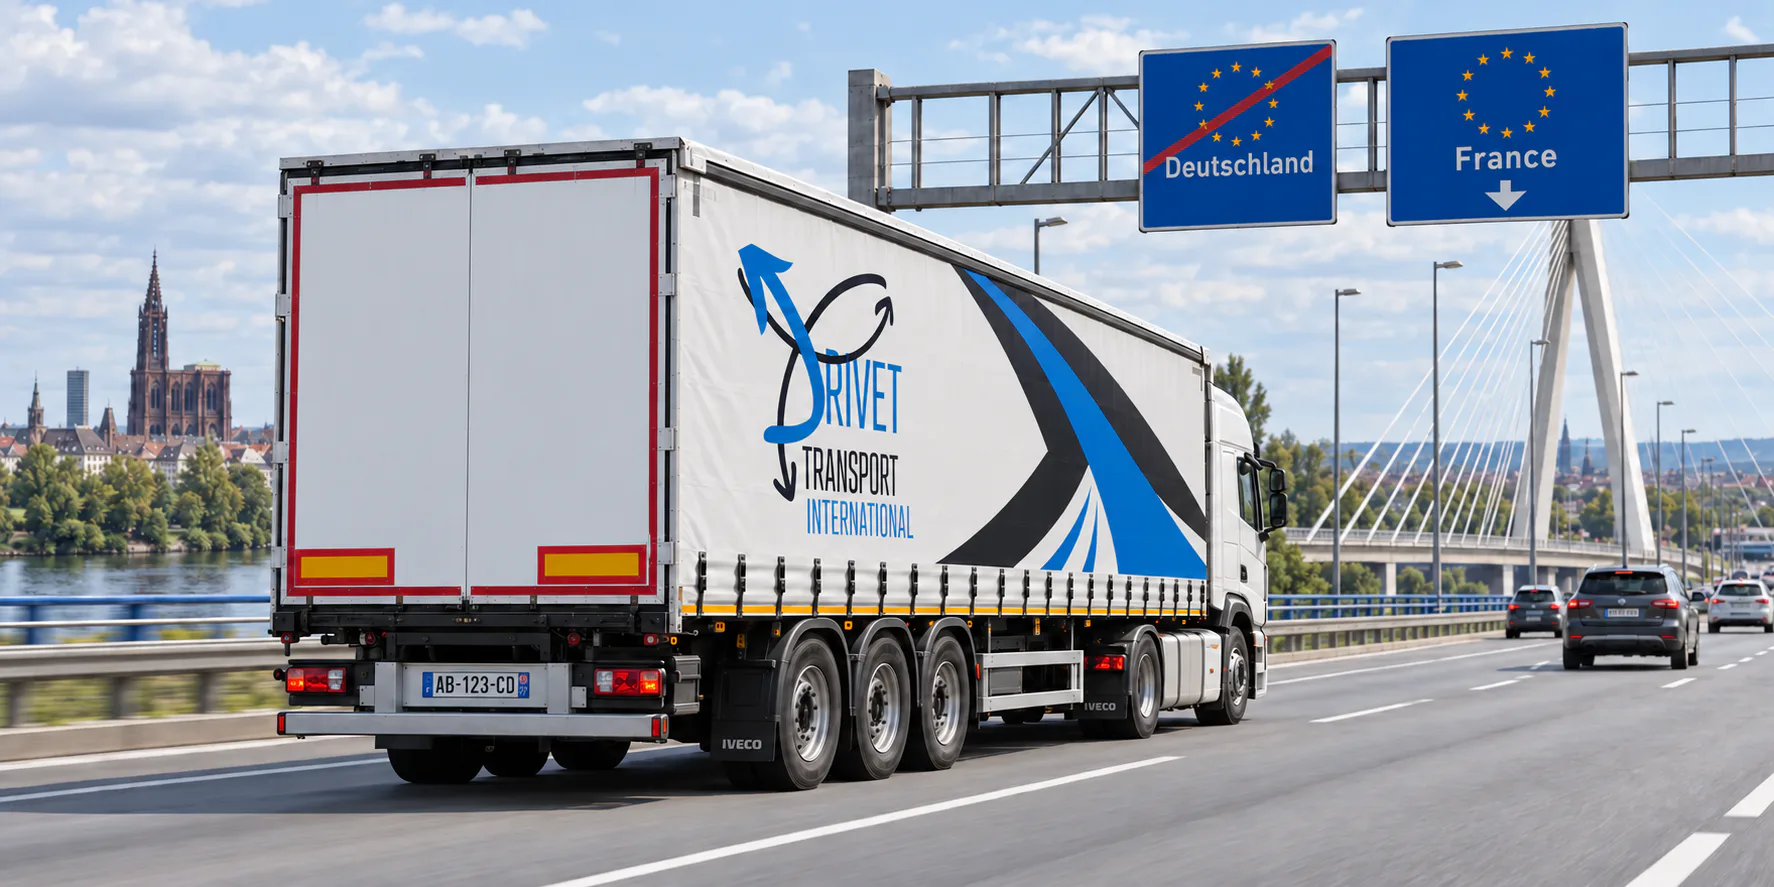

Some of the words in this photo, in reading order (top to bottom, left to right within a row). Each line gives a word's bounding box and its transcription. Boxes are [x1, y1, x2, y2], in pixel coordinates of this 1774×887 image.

[1165, 150, 1313, 179] Deutschland
[1456, 146, 1557, 171] France
[802, 446, 898, 496] TRANSPORT
[807, 498, 914, 539] INTERNATIONAL
[435, 675, 515, 694] AB-123-CD
[1084, 702, 1117, 711] IVECO
[722, 739, 762, 750] IVECO
